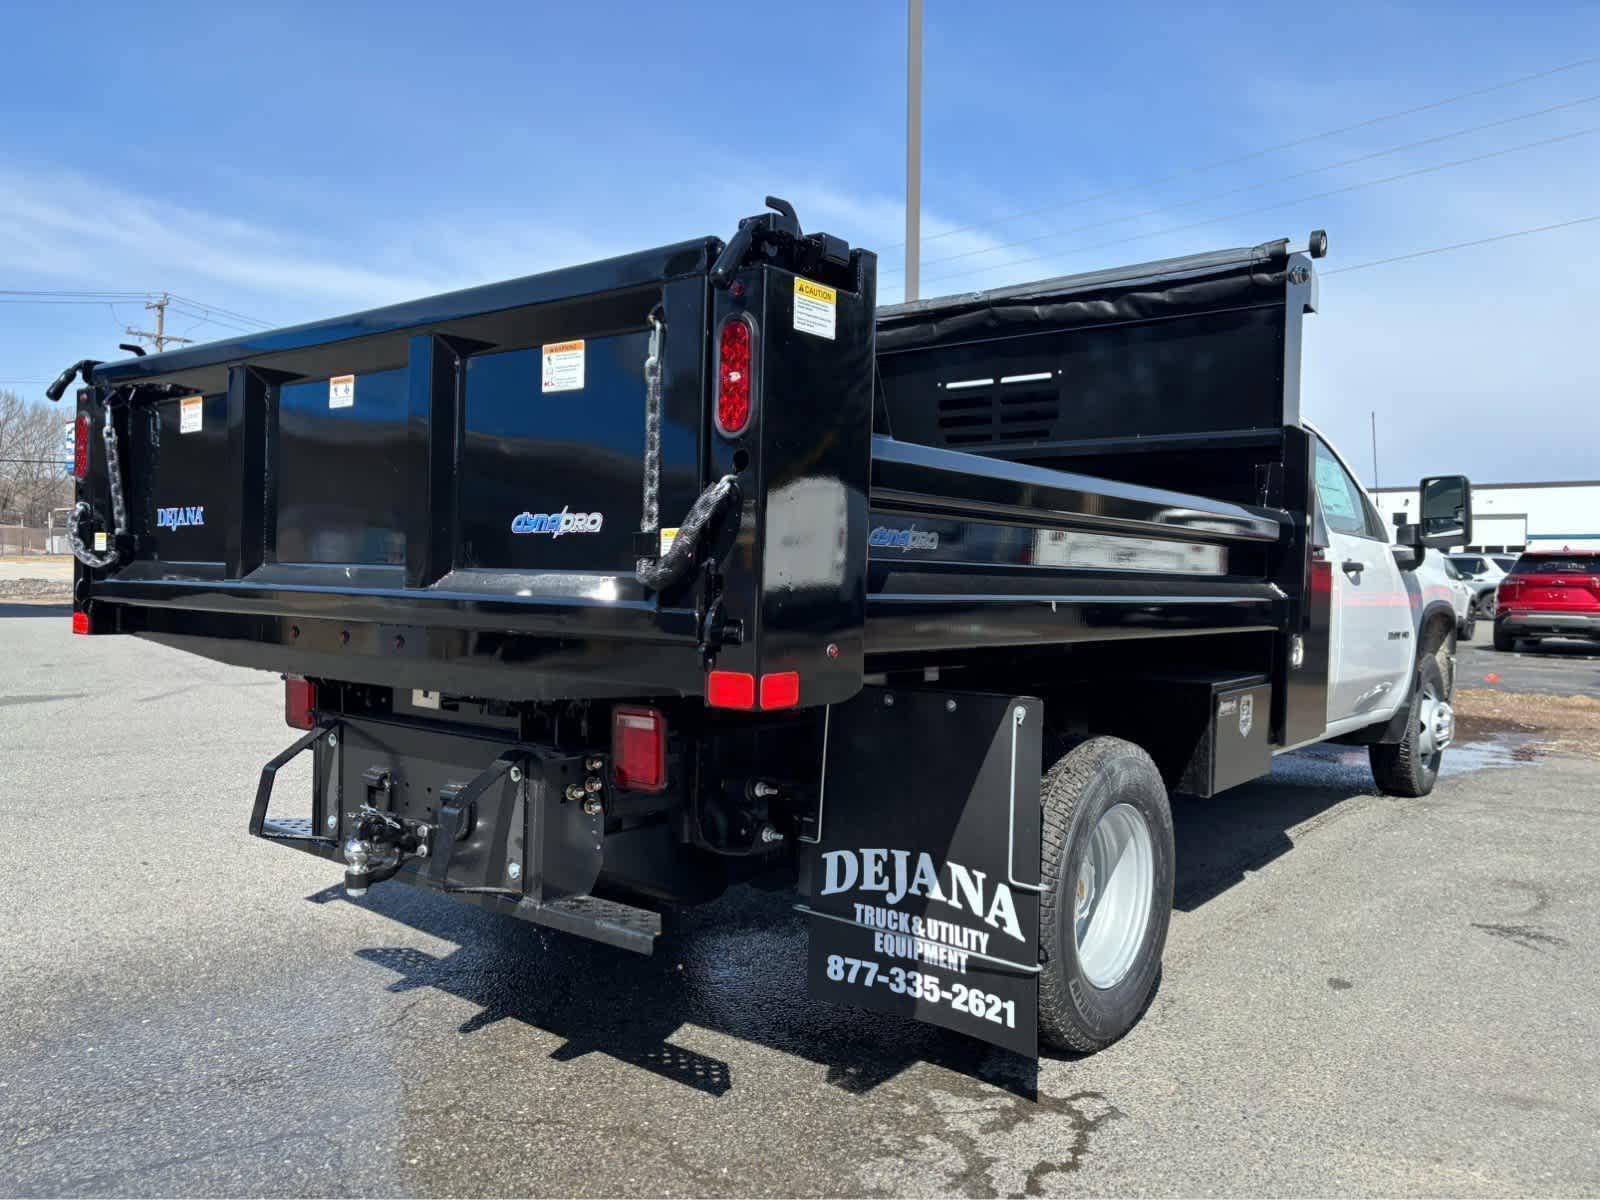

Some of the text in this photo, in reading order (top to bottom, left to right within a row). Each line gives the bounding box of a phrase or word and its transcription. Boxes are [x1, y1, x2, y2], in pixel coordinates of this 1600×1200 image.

[805, 284, 832, 301] CAUTION
[156, 506, 205, 532] DEJANA
[821, 848, 1025, 942] DEJANA
[854, 903, 911, 933] TRUCK
[926, 918, 990, 954] UTILITY
[873, 932, 970, 974] EQUIPMENT
[827, 955, 1015, 1028] 877-335-2621
